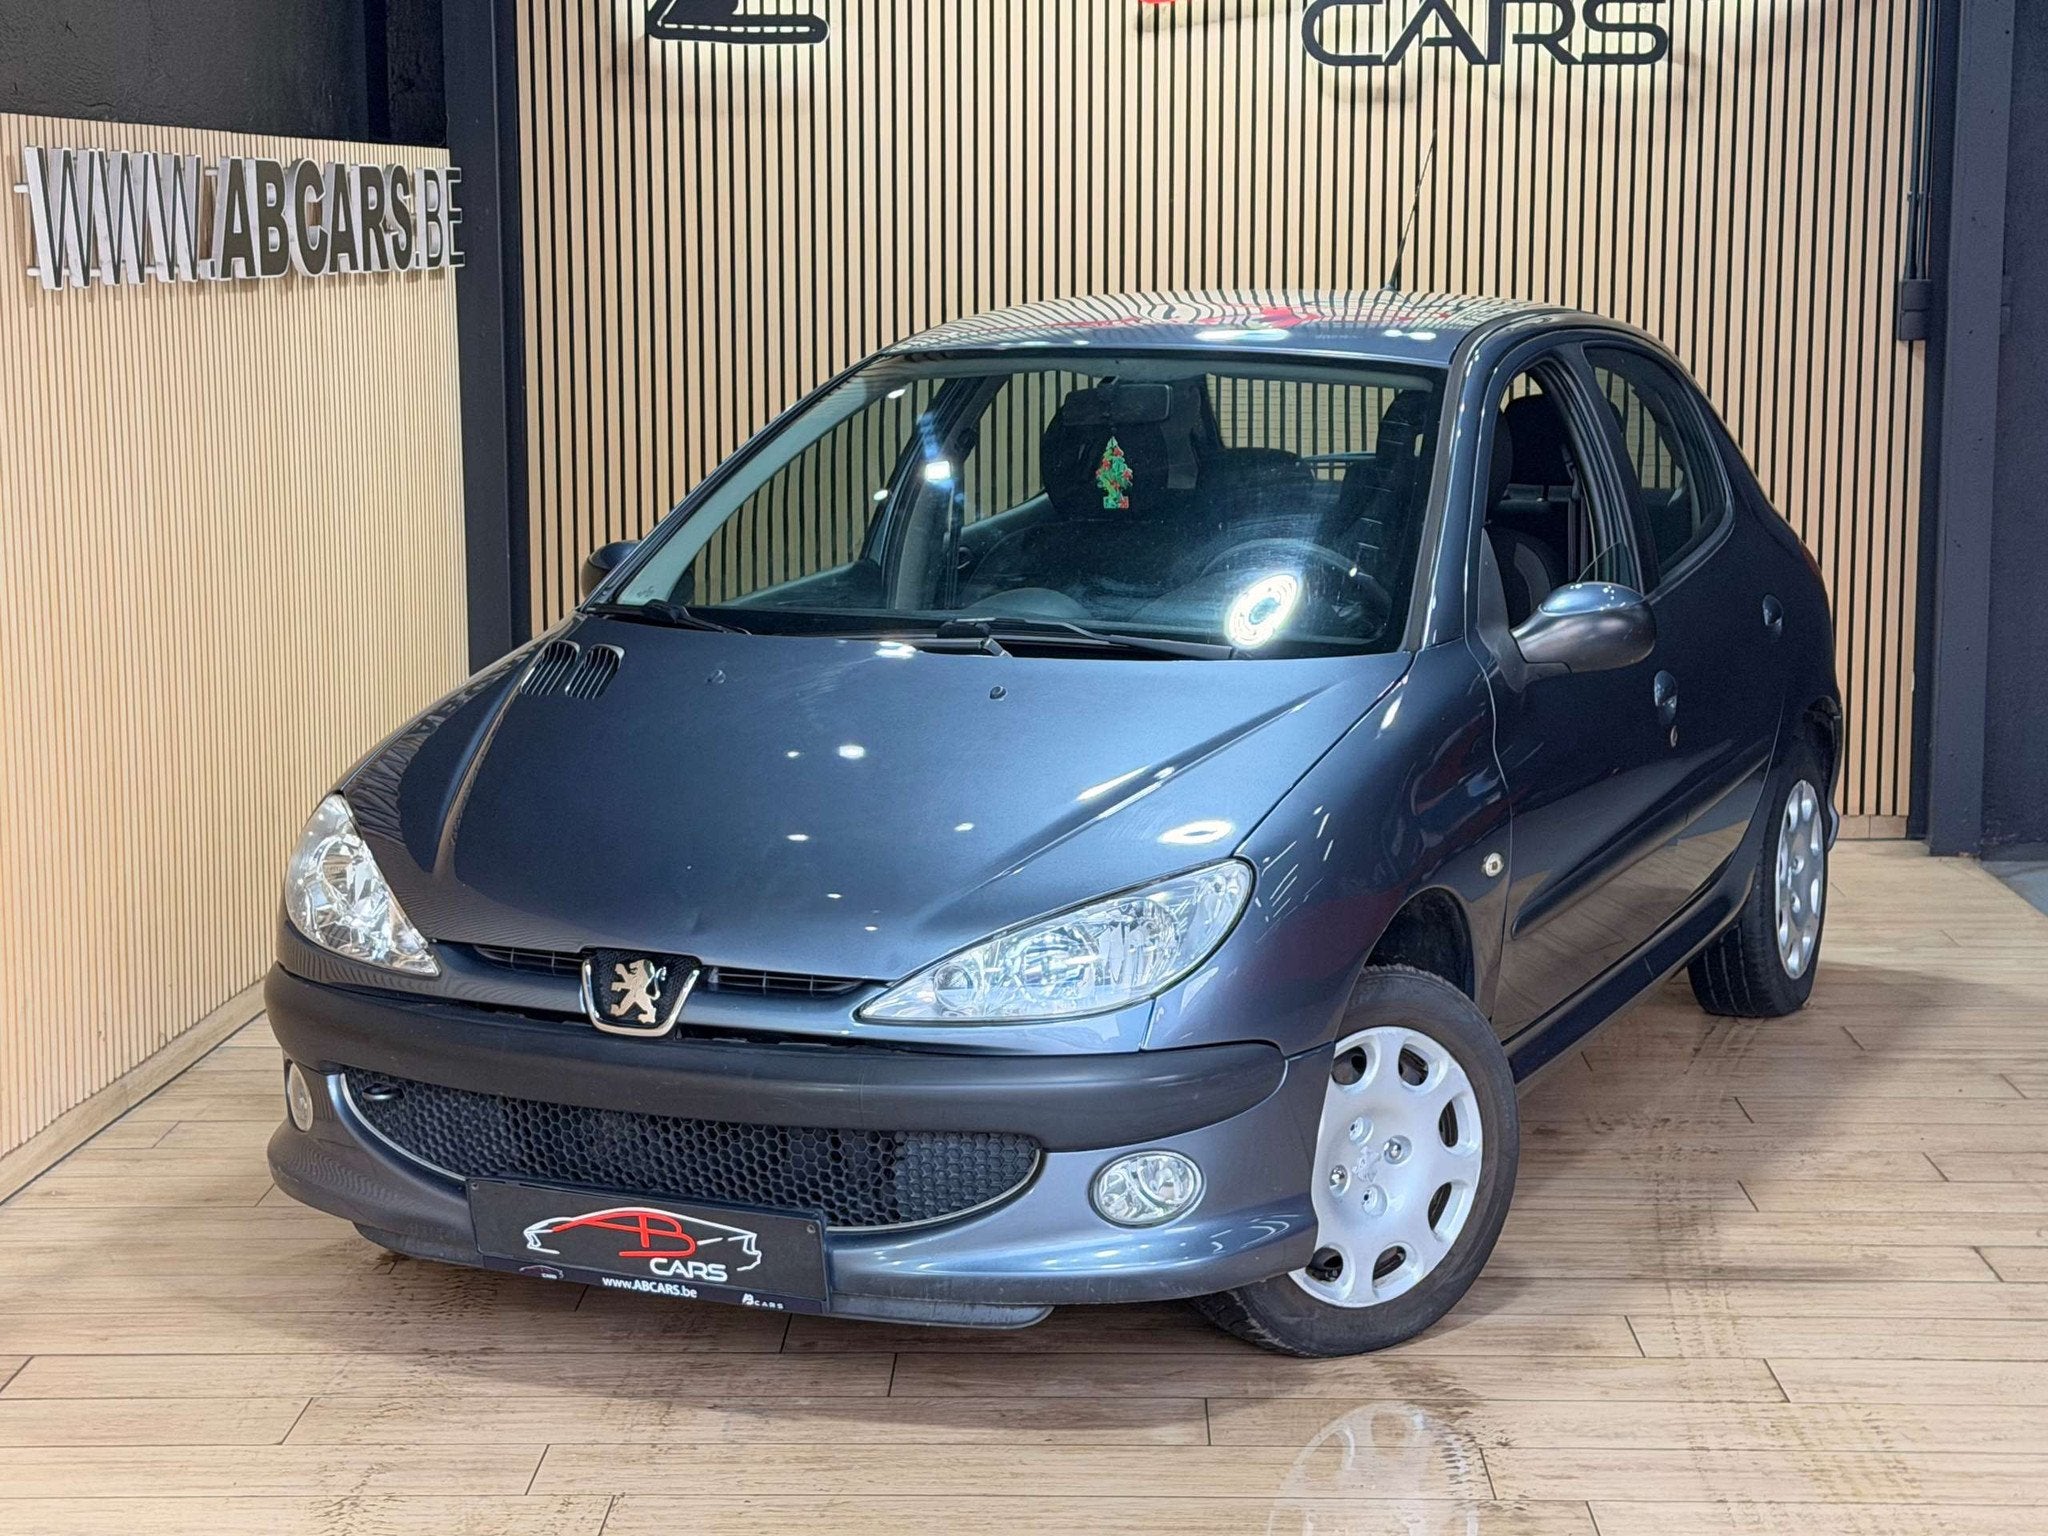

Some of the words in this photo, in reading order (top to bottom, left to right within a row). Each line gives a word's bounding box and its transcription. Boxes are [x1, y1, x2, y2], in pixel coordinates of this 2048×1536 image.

[1302, 0, 1669, 66] CARS
[24, 145, 466, 290] WWW.ABCARS.BE
[601, 1275, 698, 1299] www.ABCARS.be
[649, 1256, 728, 1282] CARS
